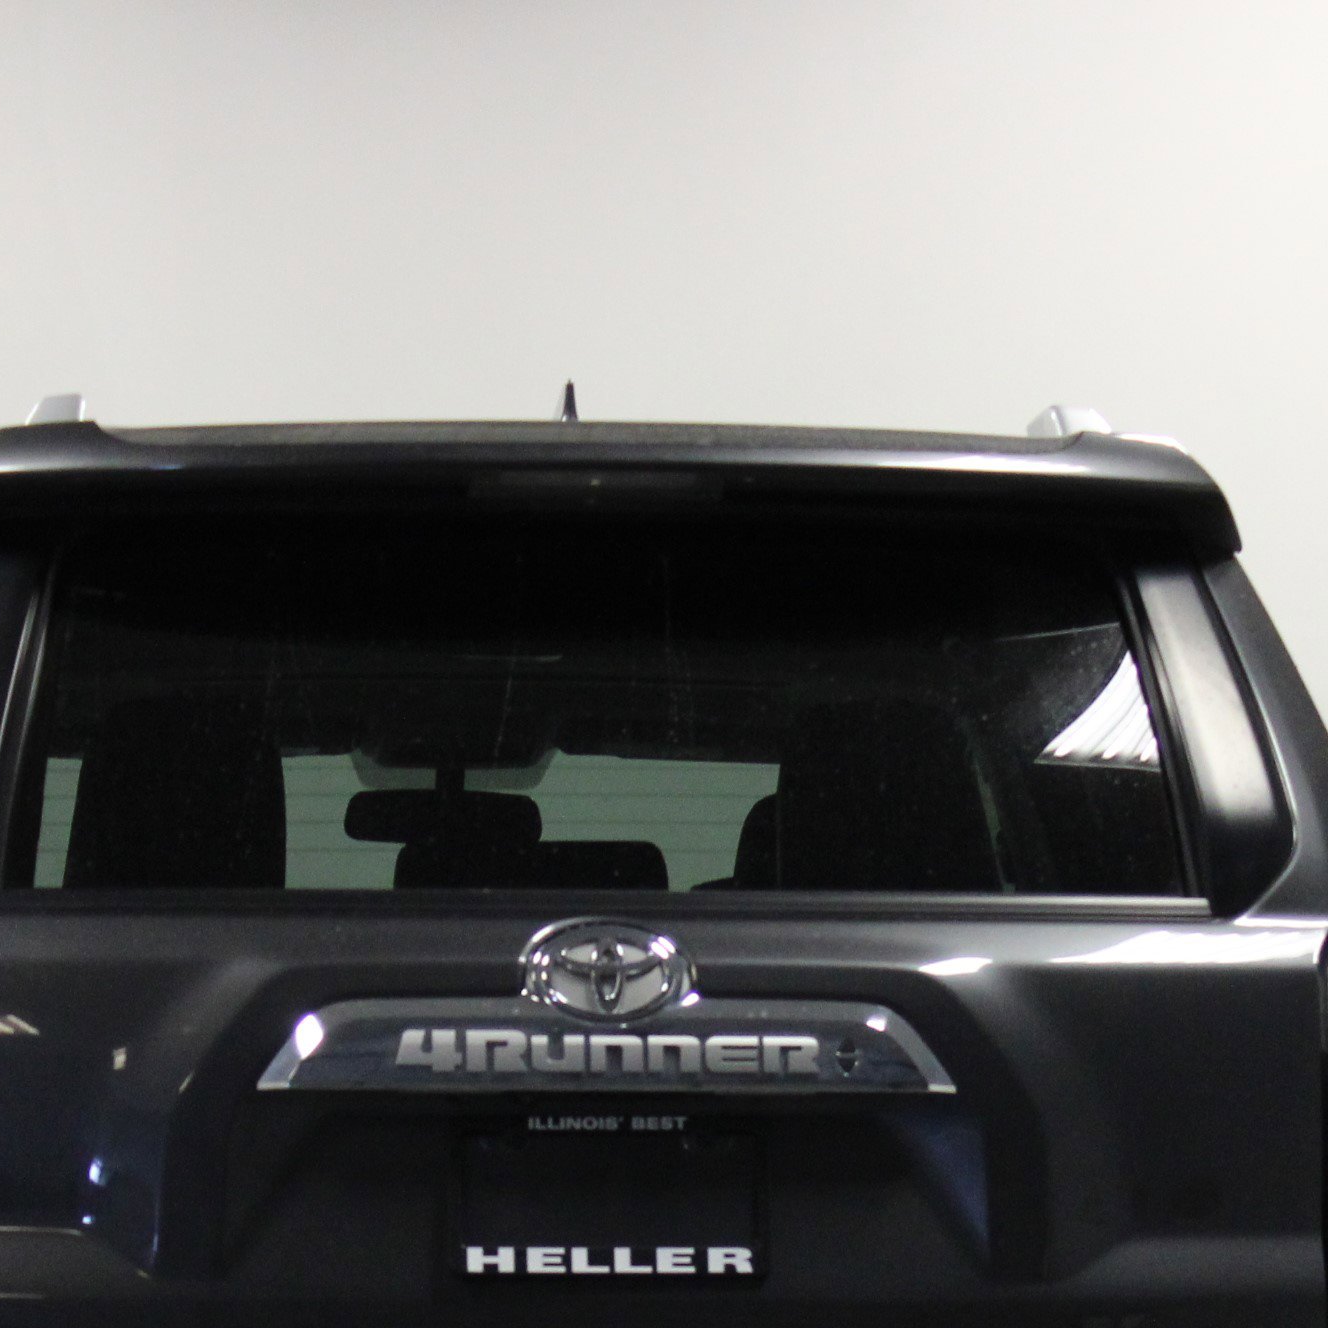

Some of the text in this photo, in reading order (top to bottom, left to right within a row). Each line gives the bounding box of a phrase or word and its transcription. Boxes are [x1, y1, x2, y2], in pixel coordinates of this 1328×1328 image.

[527, 1115, 688, 1131] ILLINOIS' BEST
[466, 1246, 754, 1275] HELLER
